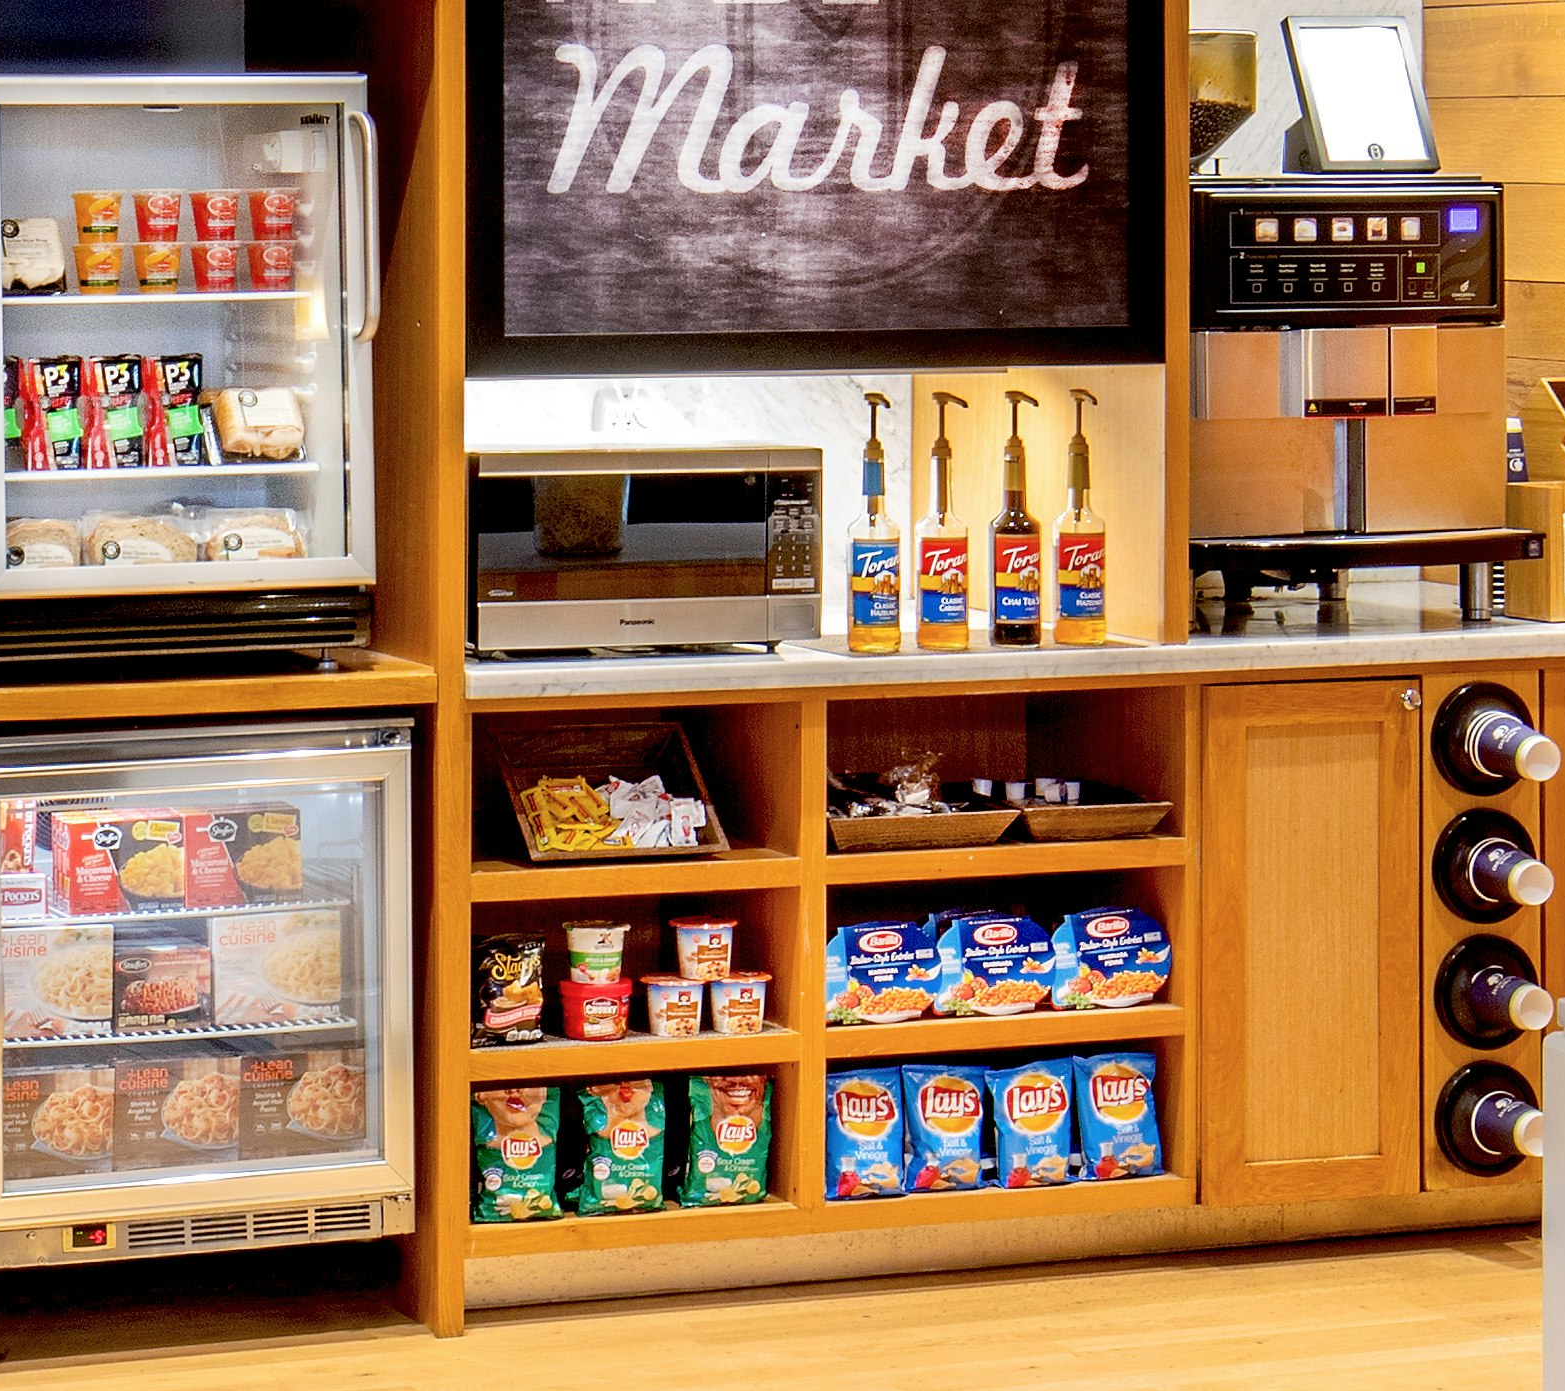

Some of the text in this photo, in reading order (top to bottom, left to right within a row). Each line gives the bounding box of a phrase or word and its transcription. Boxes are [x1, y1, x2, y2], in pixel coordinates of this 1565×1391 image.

[546, 43, 1090, 195] Market
[45, 364, 71, 387] P3
[104, 364, 130, 386] P3
[164, 363, 191, 385] P3
[240, 919, 276, 936] Lean
[983, 927, 1015, 940] Barilla
[1096, 919, 1127, 932] Barilla
[12, 933, 47, 947] Lean
[219, 929, 276, 946] cuisine
[869, 934, 901, 948] Barilla
[2, 945, 47, 959] uisine
[137, 1067, 168, 1078] Lean
[259, 1059, 293, 1071] Lean
[119, 1076, 168, 1090] cuisine
[243, 1069, 293, 1083] cuisine
[1095, 1075, 1149, 1108] Lay's
[840, 1092, 890, 1124] Lay's
[925, 1086, 977, 1119] Lay's
[1012, 1084, 1062, 1120] Lay's
[613, 1127, 647, 1150] Lay's
[721, 1121, 754, 1143] Lay's
[506, 1138, 539, 1159] Lay's
